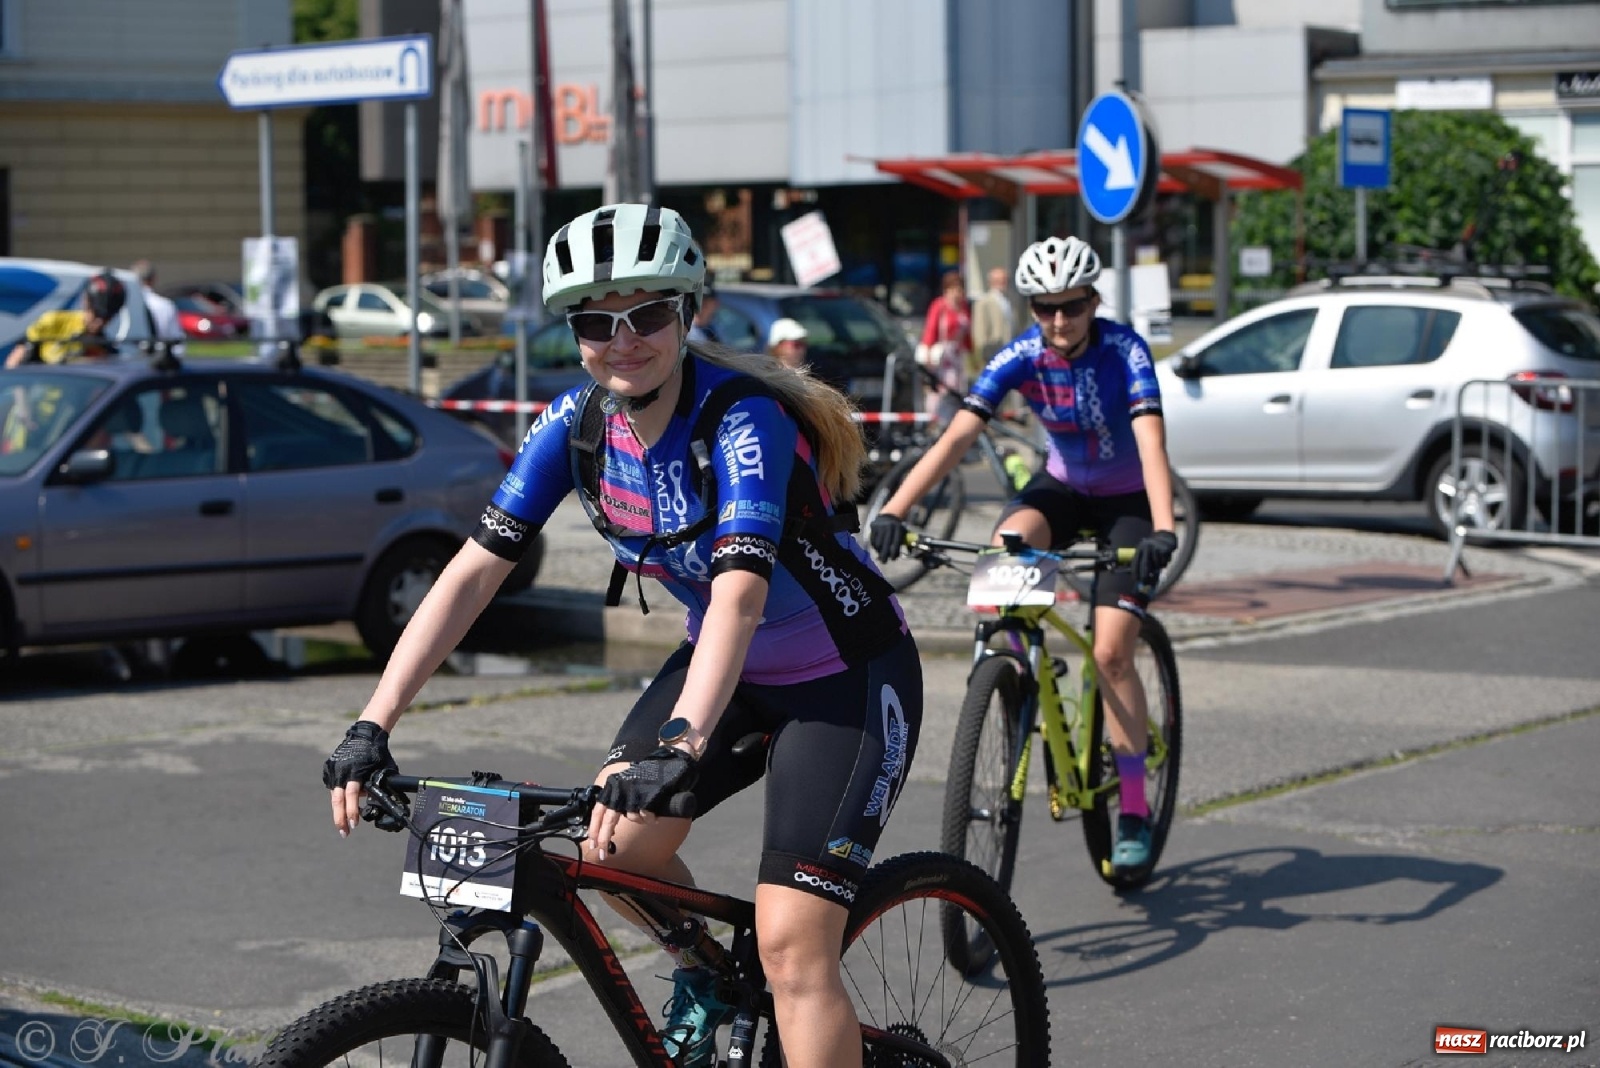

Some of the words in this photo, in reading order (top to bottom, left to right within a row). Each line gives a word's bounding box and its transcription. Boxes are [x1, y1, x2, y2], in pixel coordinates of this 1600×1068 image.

[987, 565, 1042, 587] 1020
[863, 717, 901, 817] WEILANDT
[429, 826, 487, 868] 1013
